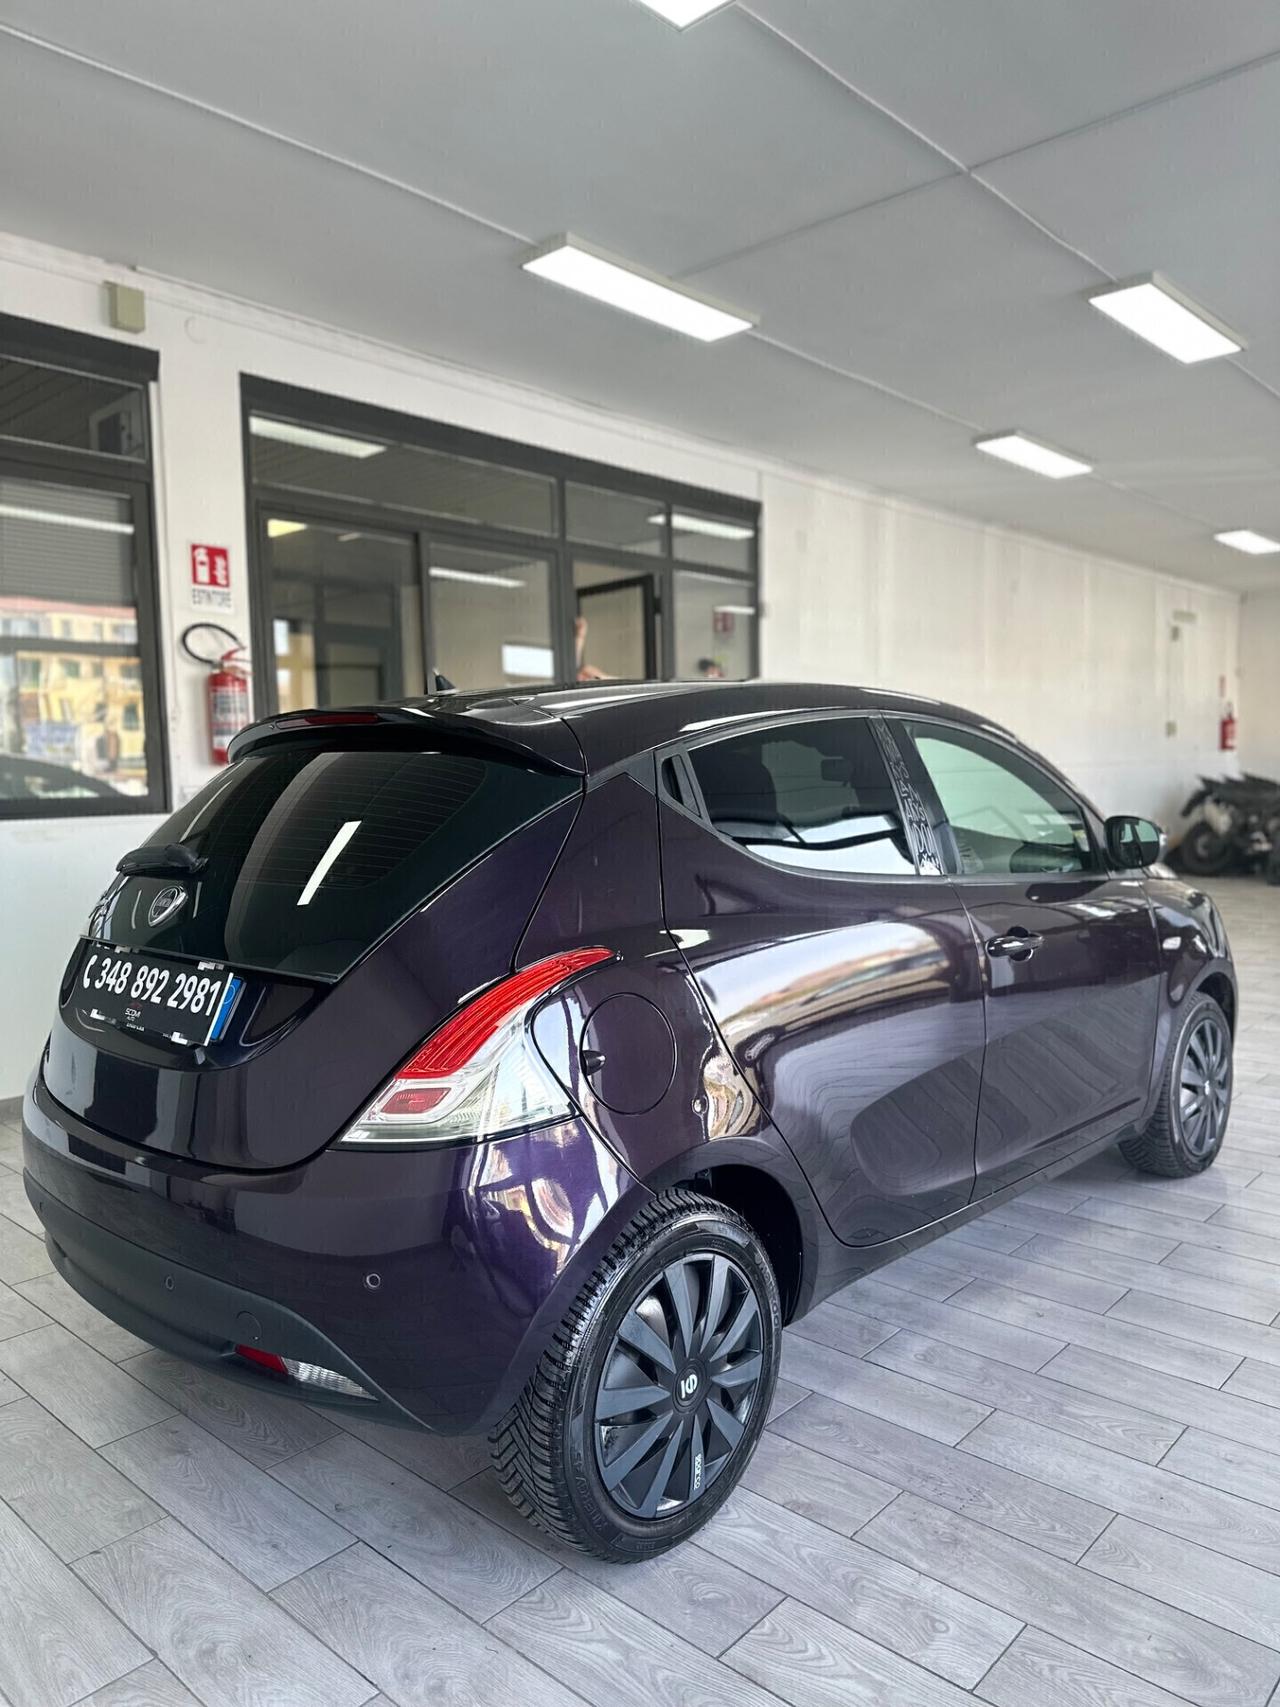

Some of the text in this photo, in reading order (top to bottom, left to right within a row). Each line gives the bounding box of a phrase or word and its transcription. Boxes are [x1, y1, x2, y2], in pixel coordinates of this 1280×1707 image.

[94, 957, 222, 1016] 348 892 2981
